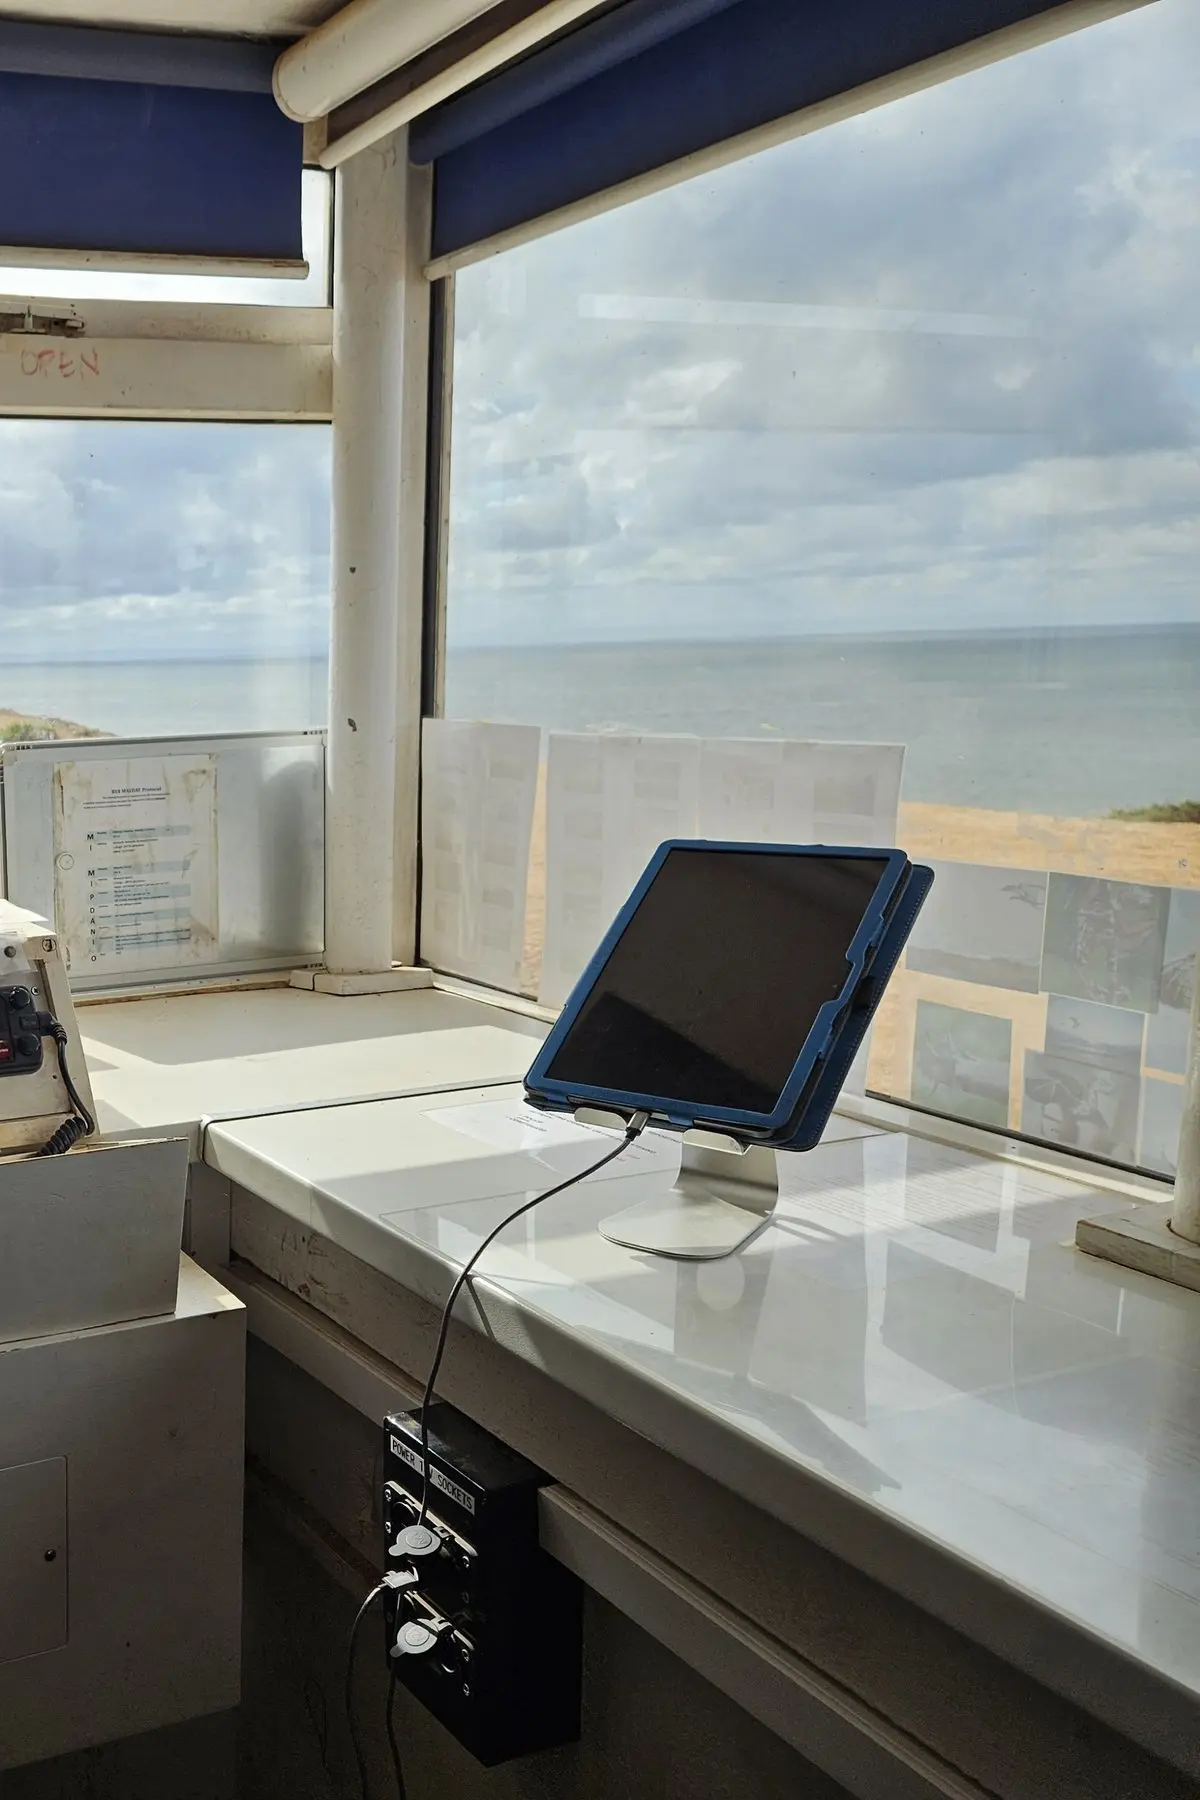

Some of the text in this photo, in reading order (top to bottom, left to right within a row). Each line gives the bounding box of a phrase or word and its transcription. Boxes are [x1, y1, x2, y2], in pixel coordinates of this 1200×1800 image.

[20, 349, 100, 378] OPEN
[392, 1439, 415, 1466] POWER
[437, 1474, 472, 1510] SOCKETS
